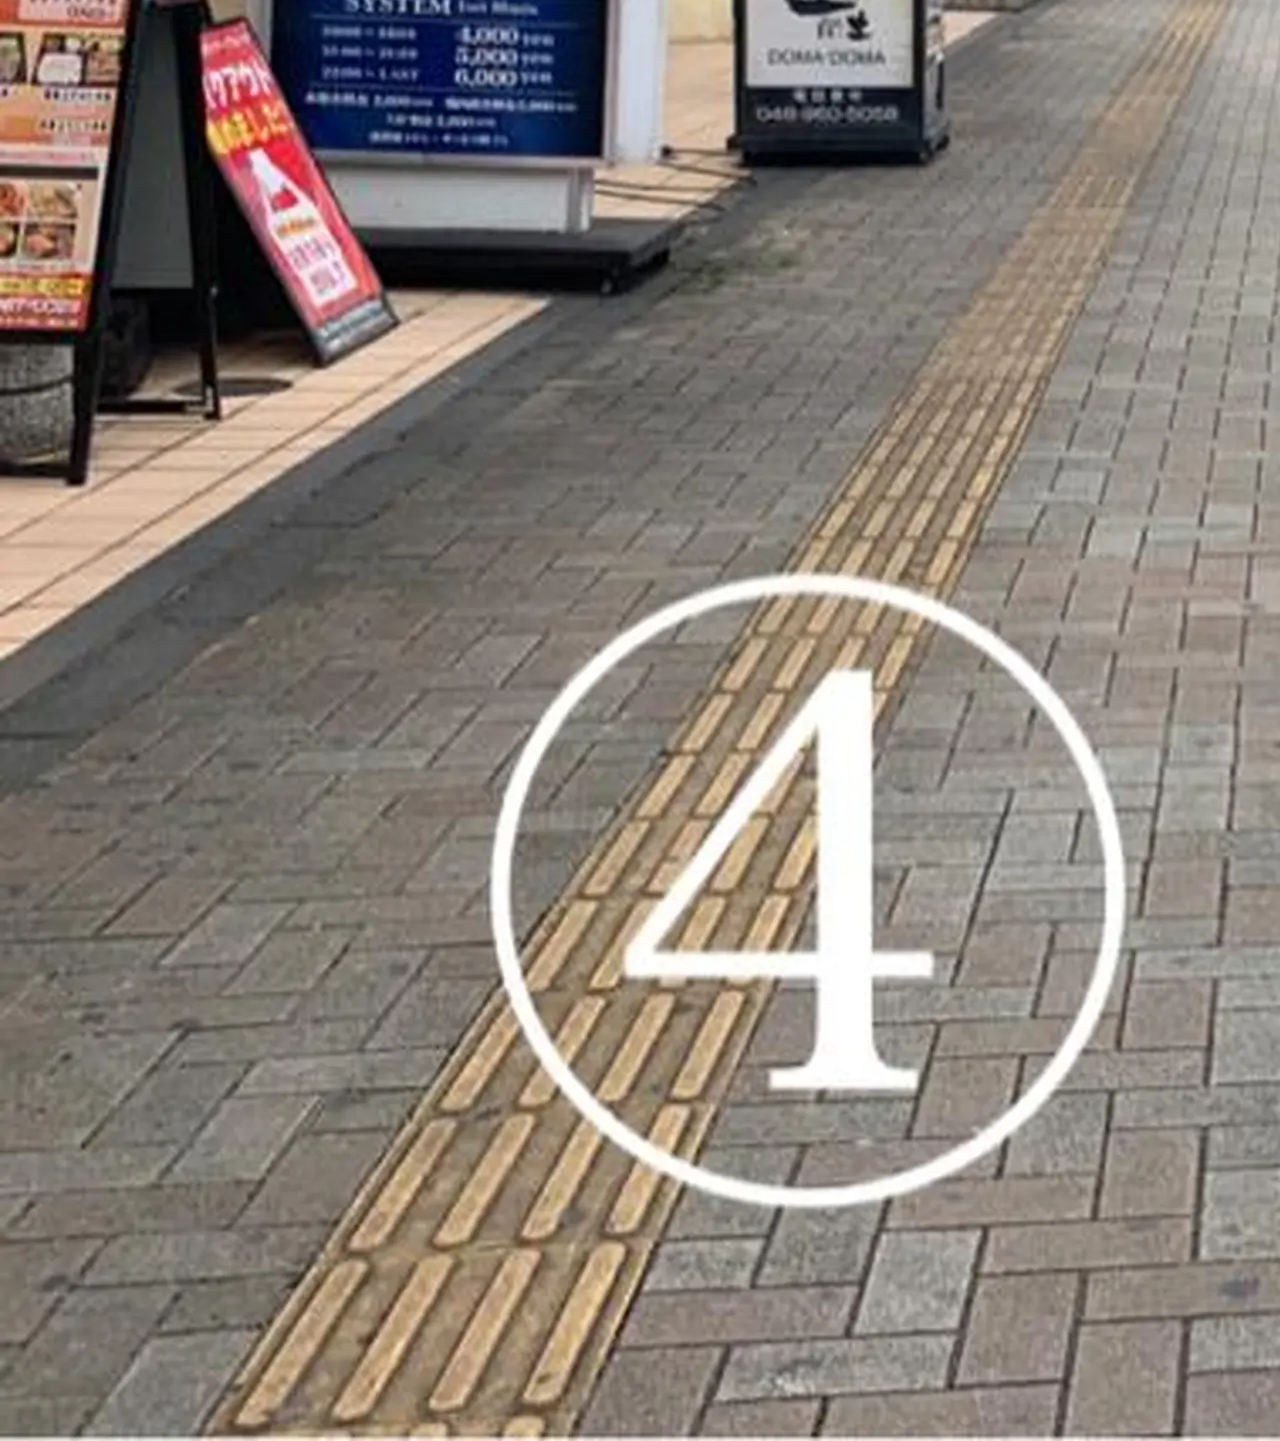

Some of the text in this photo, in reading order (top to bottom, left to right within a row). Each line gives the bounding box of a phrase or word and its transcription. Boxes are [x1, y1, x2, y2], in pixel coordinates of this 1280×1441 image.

[455, 45, 518, 66] 5,000
[766, 47, 886, 67] DOMA-DOMA
[454, 67, 517, 87] 6,000
